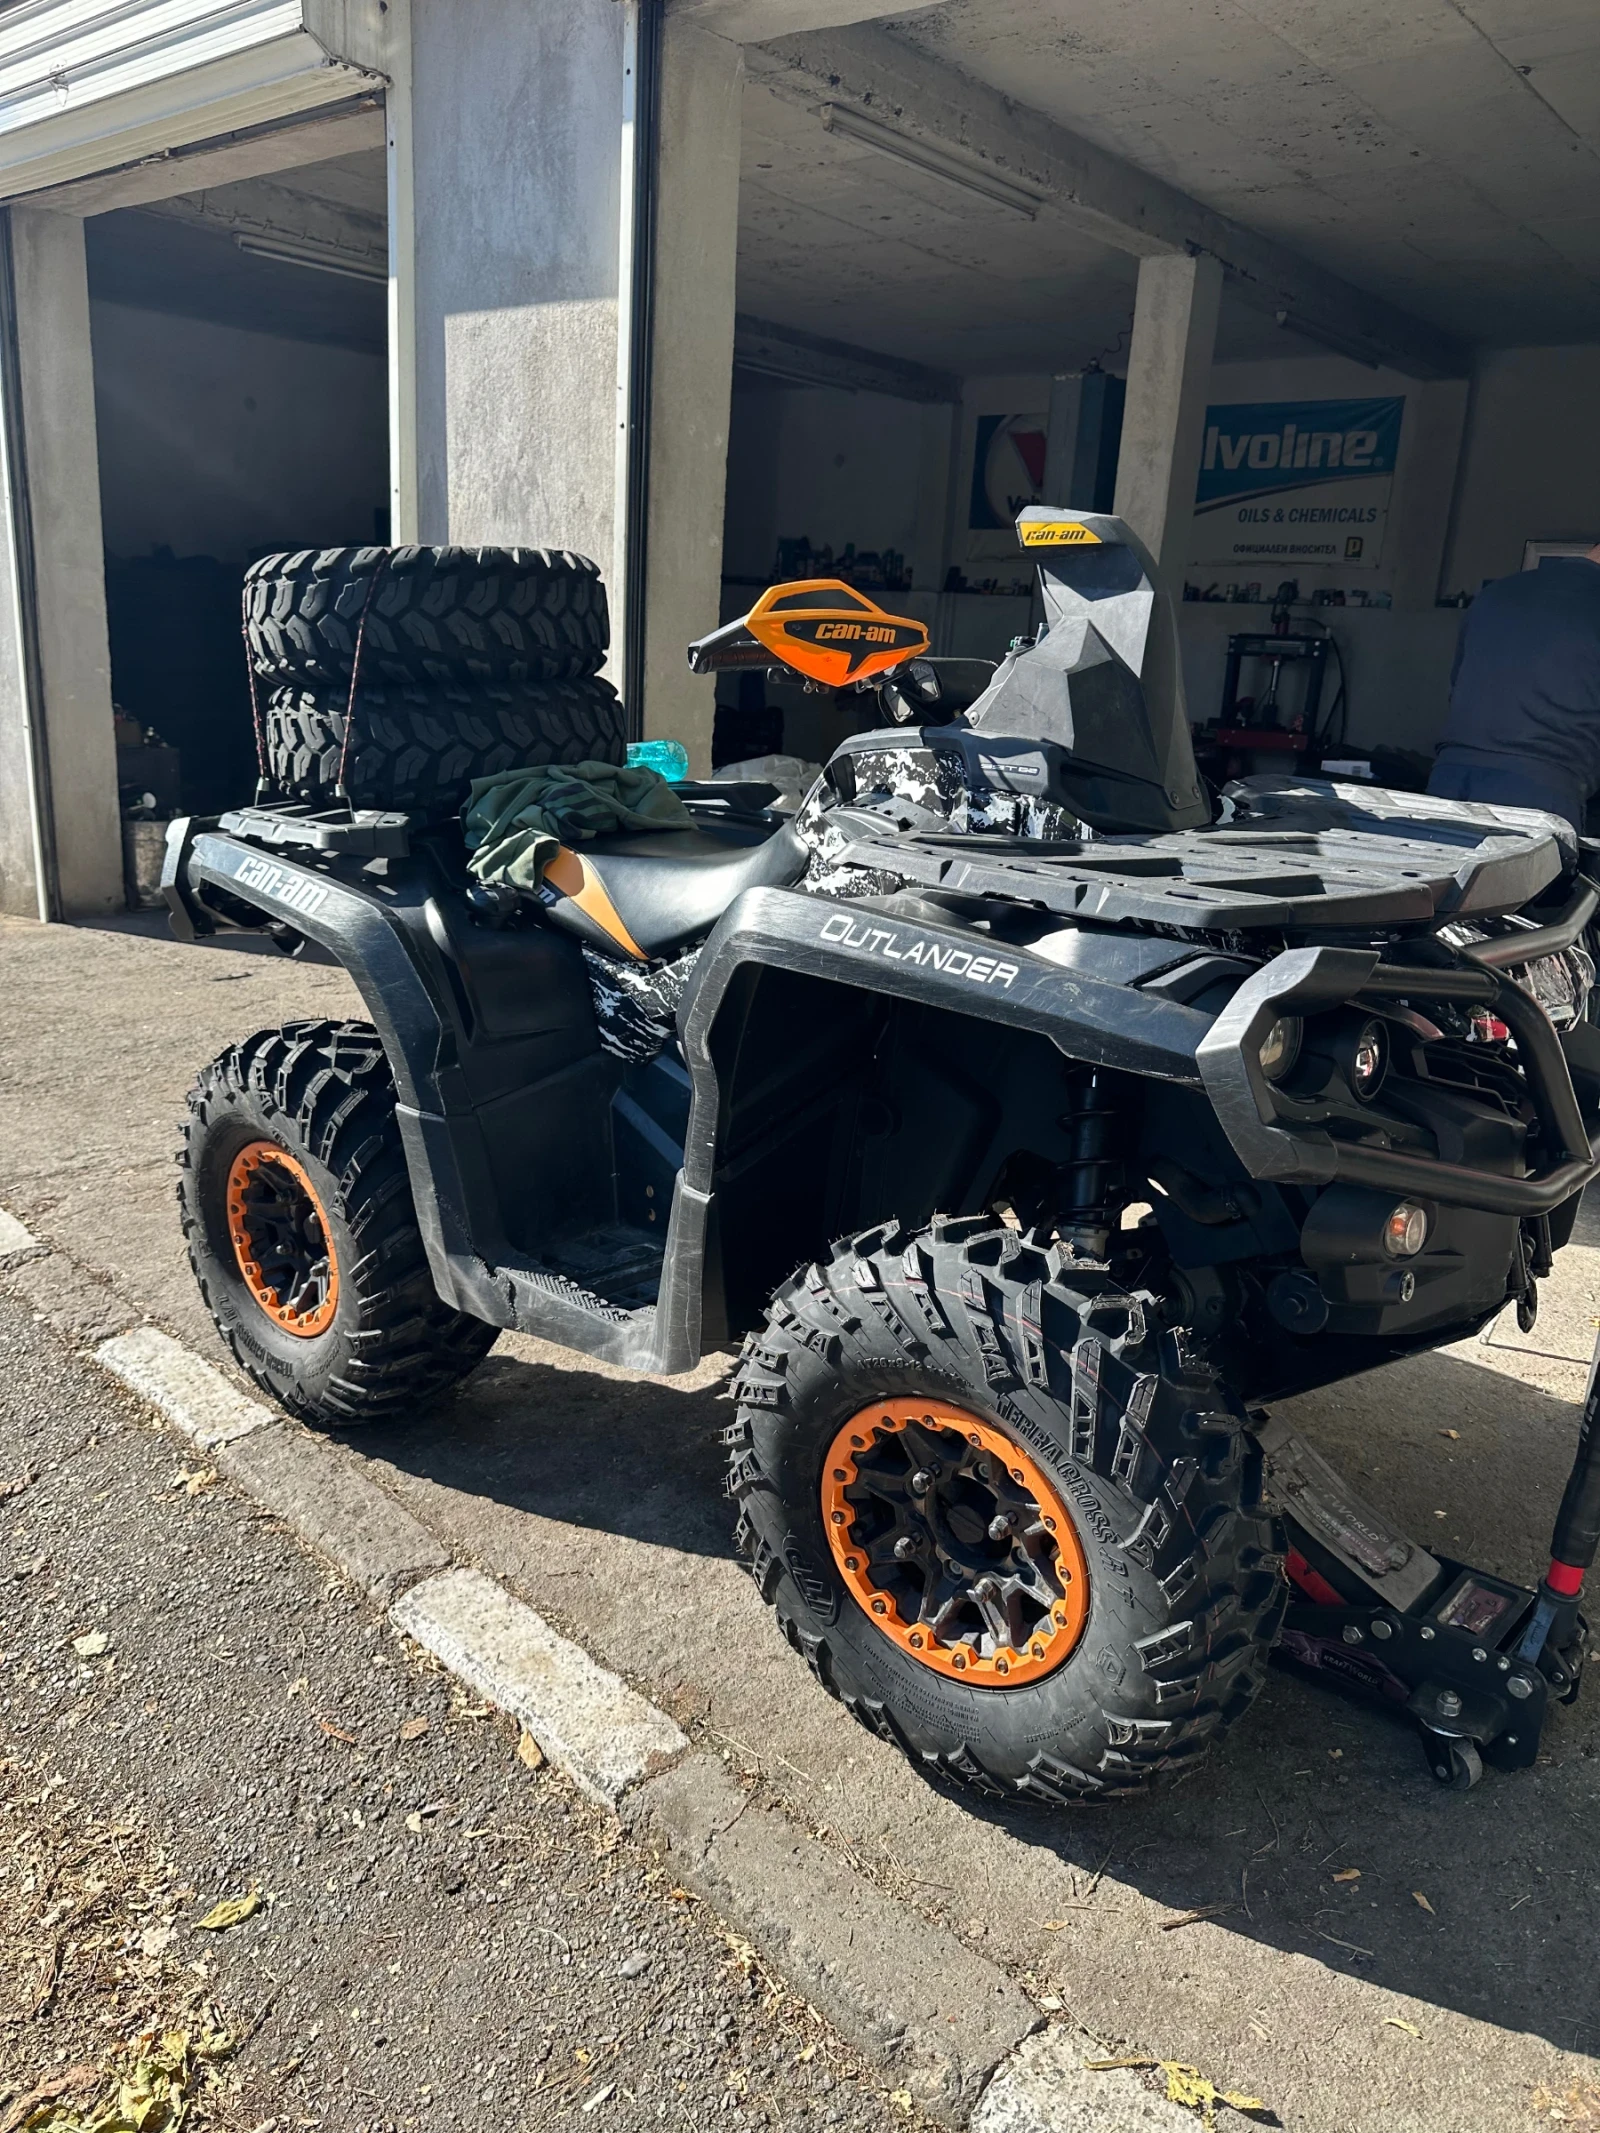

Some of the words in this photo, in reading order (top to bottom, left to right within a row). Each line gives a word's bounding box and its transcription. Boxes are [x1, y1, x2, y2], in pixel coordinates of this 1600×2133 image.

[1238, 508, 1270, 523] OILS
[1273, 508, 1284, 523] &
[1288, 507, 1377, 523] CHEMICALS
[815, 622, 897, 644] can-am
[234, 856, 328, 914] can-am
[820, 914, 1020, 988] OUTLANDER
[997, 1394, 1064, 1465] TERRA
[1057, 1461, 1117, 1543] CROSS
